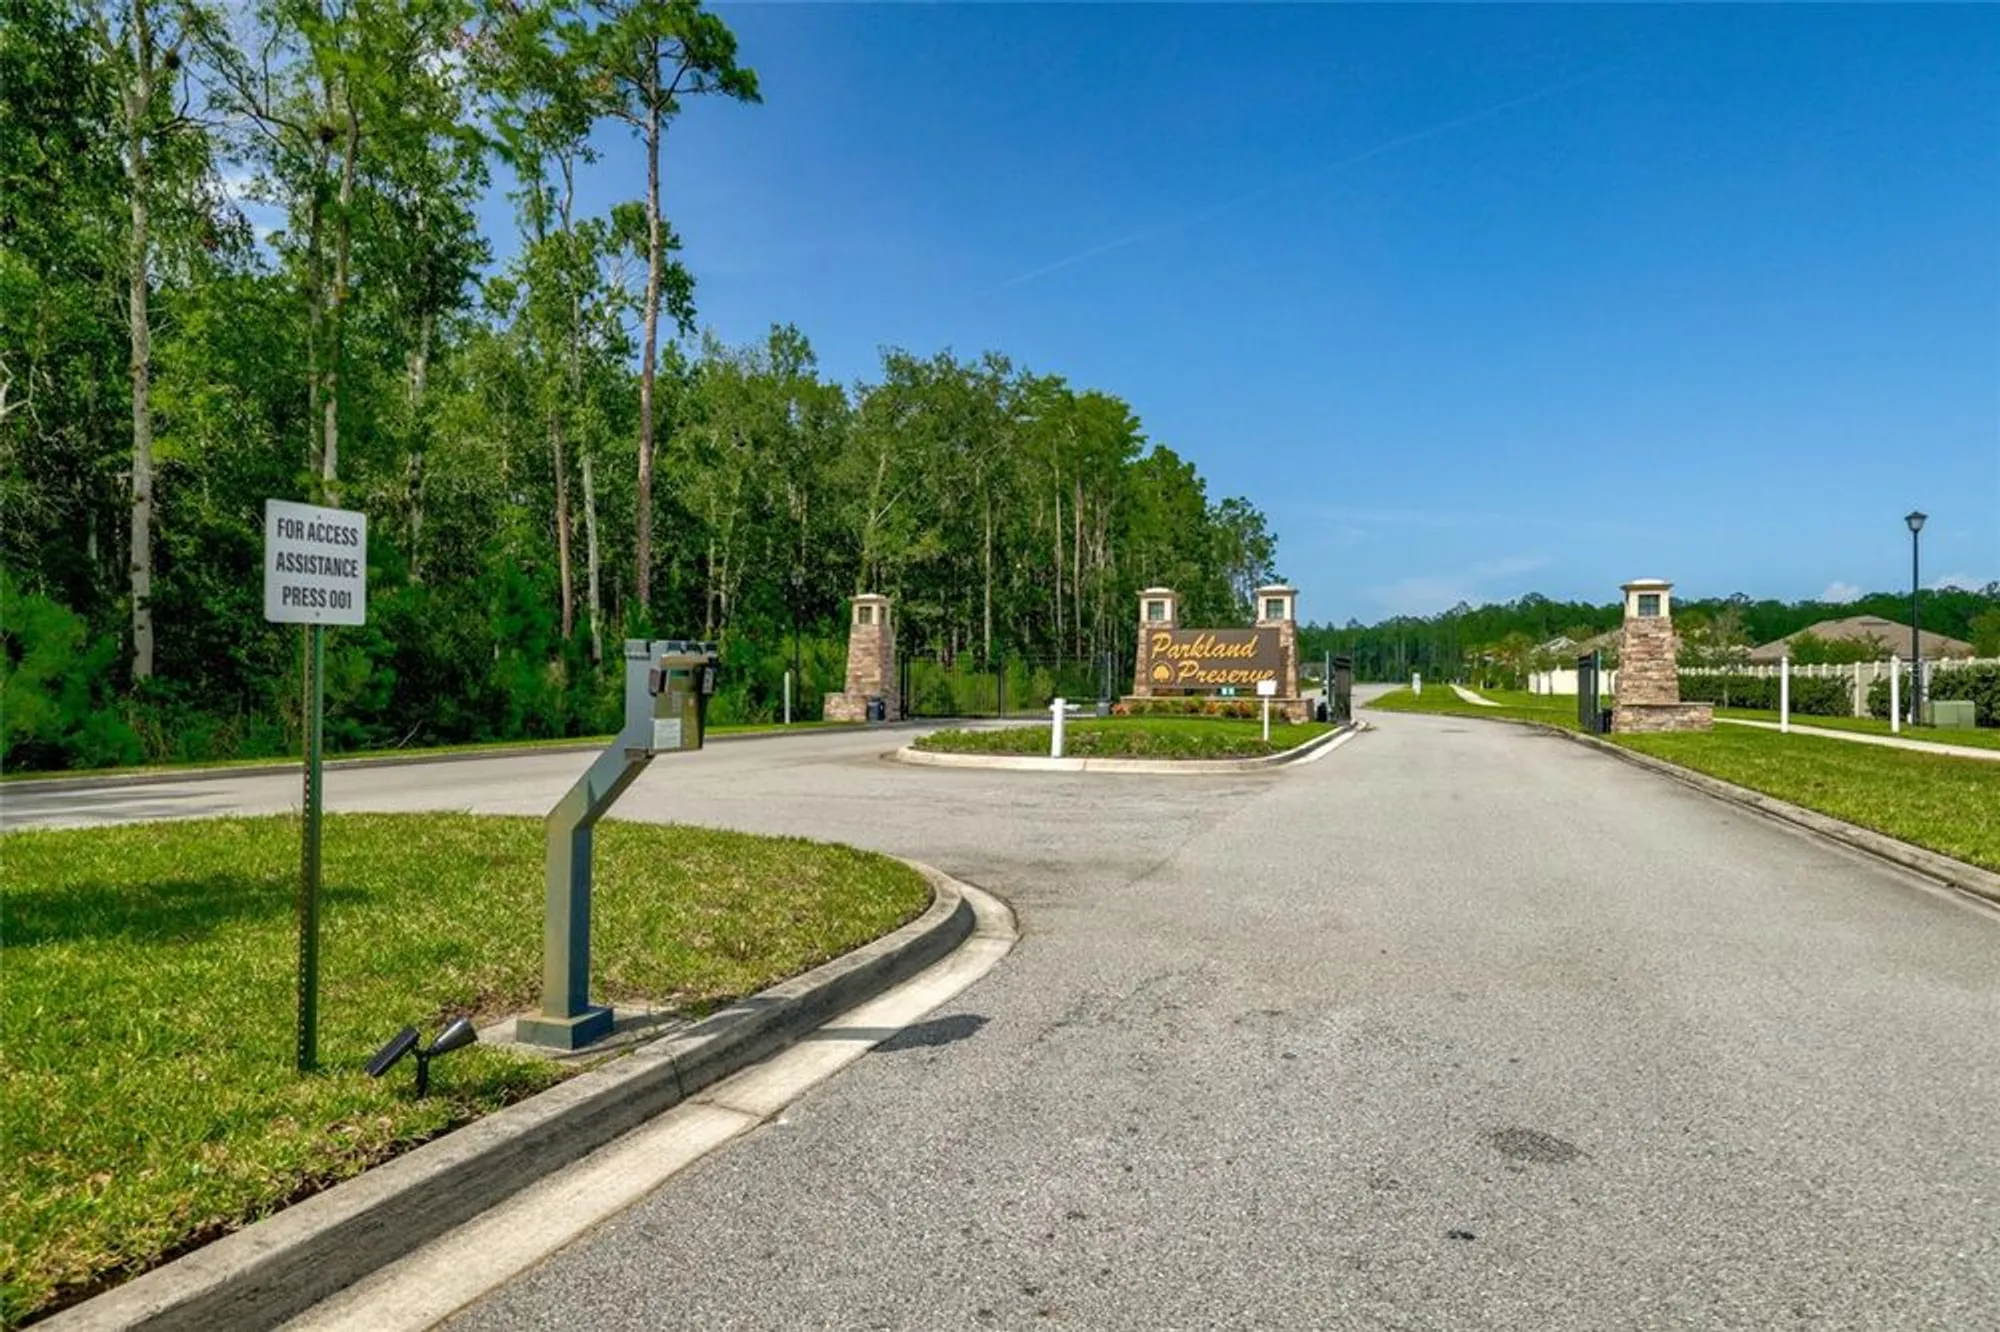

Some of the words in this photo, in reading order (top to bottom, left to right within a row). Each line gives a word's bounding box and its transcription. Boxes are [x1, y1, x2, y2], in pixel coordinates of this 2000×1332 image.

[277, 518, 304, 540] FOR
[307, 522, 359, 546] ACCESS
[276, 551, 359, 578] ASSISTANCE
[282, 586, 327, 608] PRESS
[329, 590, 352, 609] 001
[1151, 631, 1259, 659] Parkland
[1176, 660, 1276, 684] Preserve
